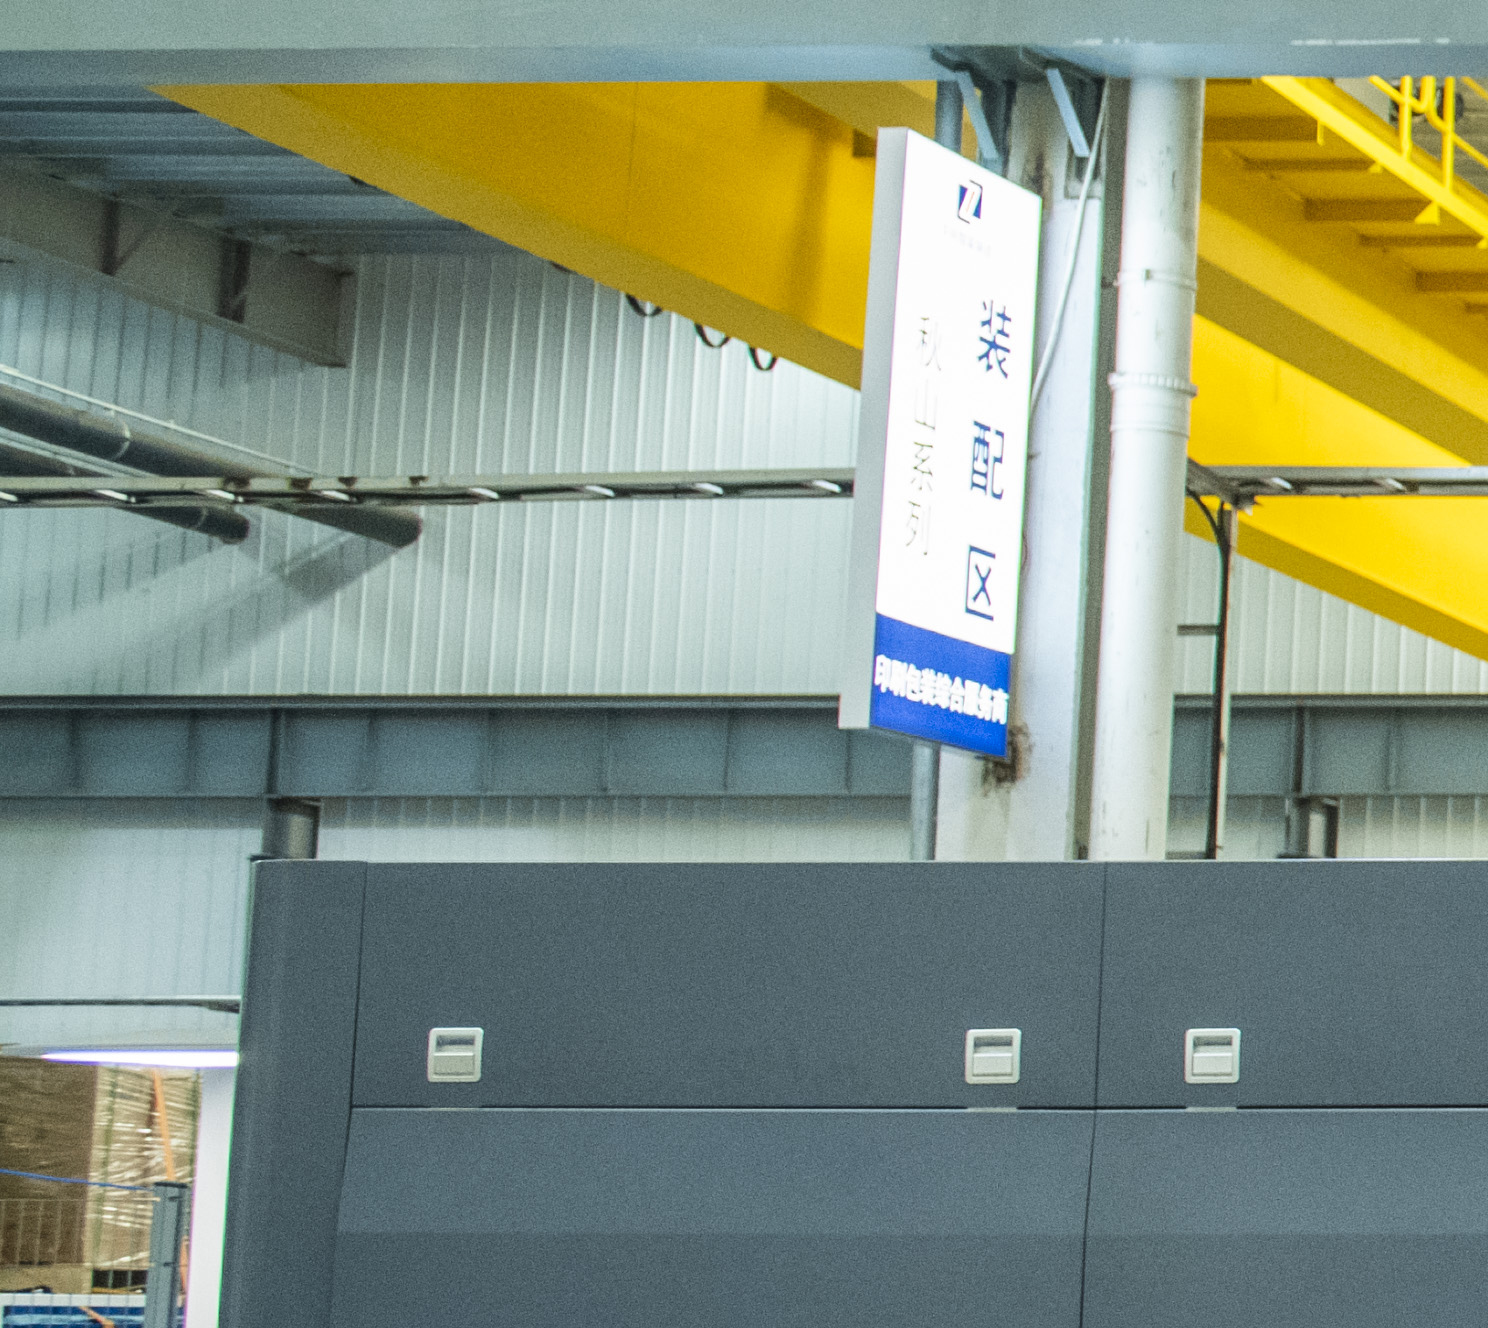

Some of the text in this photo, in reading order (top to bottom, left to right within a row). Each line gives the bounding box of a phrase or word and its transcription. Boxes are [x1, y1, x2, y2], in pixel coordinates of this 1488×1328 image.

[905, 315, 942, 557] 秋山系列
[965, 299, 1012, 622] 装配区
